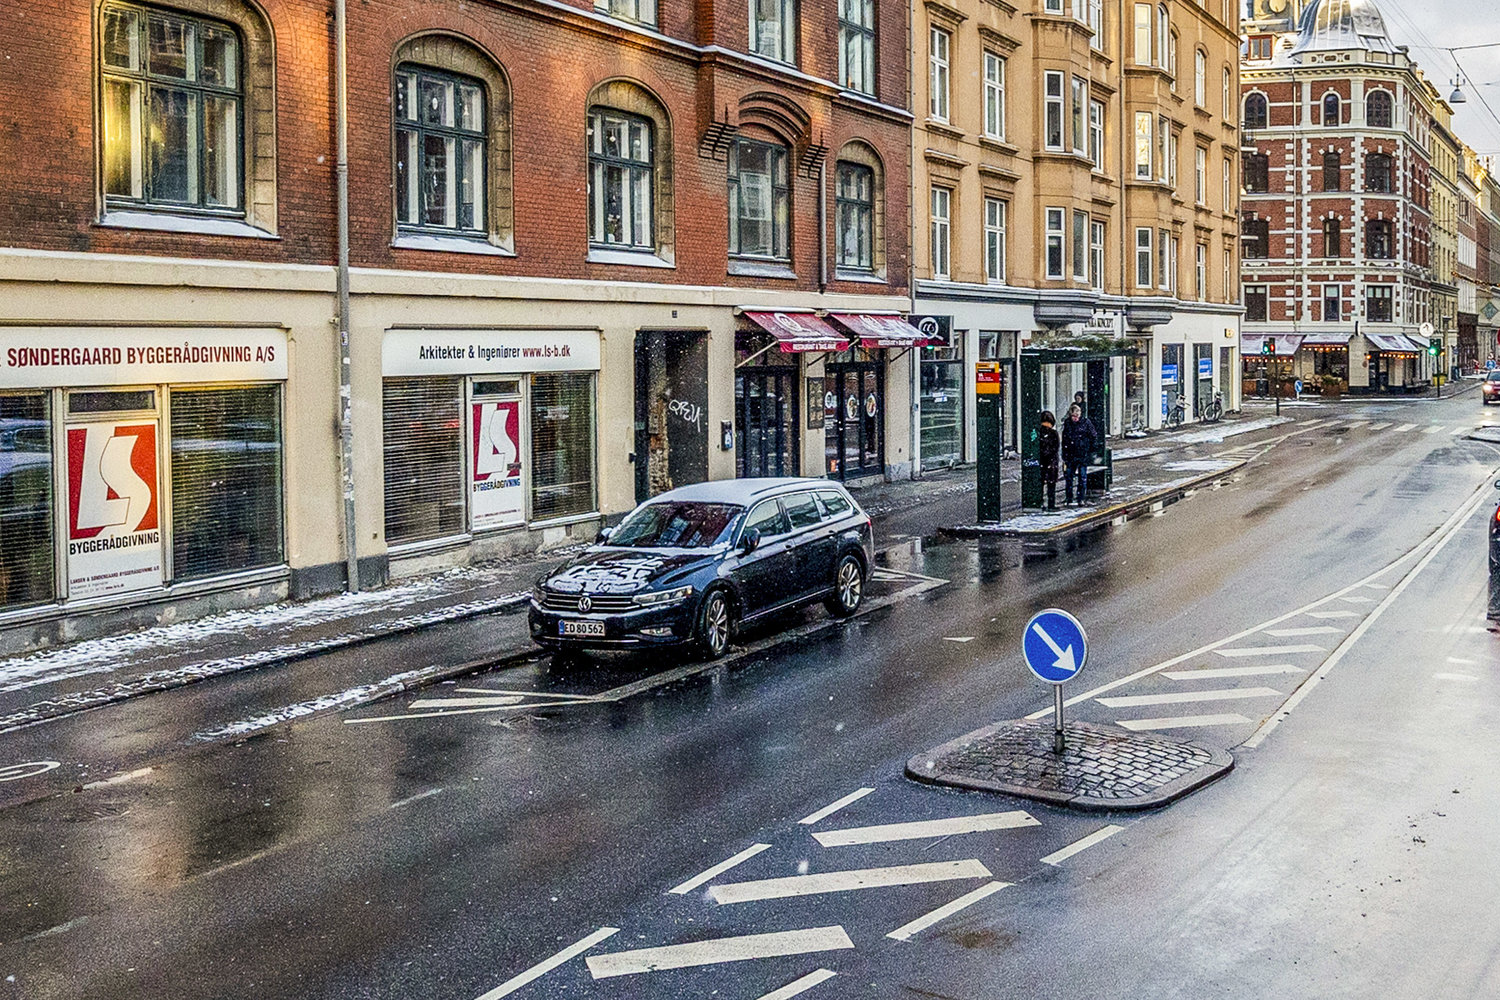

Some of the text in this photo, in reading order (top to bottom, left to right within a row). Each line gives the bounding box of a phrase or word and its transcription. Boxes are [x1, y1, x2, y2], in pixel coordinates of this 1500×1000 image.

[7, 341, 275, 367] SØNDERGAARD BYGGERÅDGIVNING A/S
[419, 344, 571, 361] Arkitekter & Ingeniører www.ls-b.dk
[473, 478, 521, 492] BYGGERÅDGIVNING
[69, 531, 160, 556] BYGGERÅDGIVNING
[564, 623, 603, 634] ED 80 562
